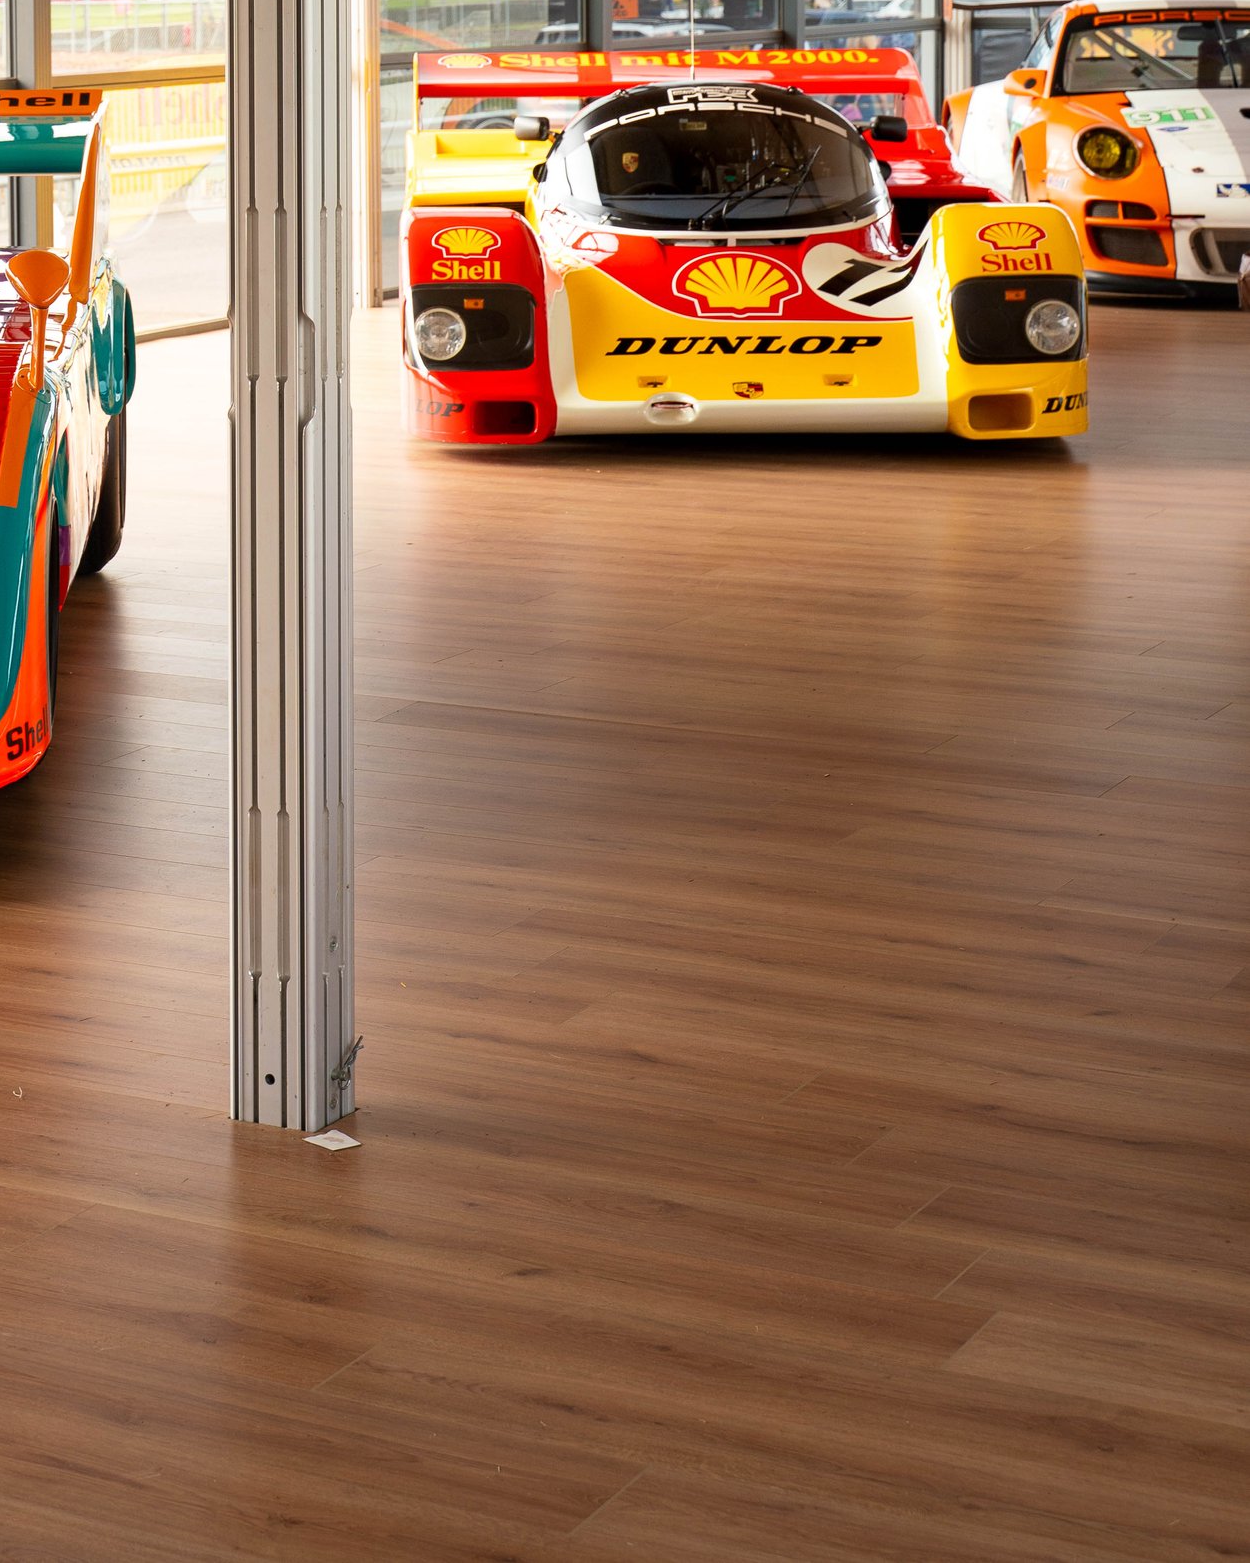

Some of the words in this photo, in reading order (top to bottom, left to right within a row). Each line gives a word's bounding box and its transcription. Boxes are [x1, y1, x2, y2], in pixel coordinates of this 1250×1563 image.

[499, 53, 607, 68] Shell
[620, 52, 701, 67] mit
[584, 102, 848, 140] PORSCHE
[1130, 106, 1209, 125] 911
[431, 260, 501, 280] Shell
[981, 252, 1054, 273] Shell
[606, 335, 883, 356] DUNLOP
